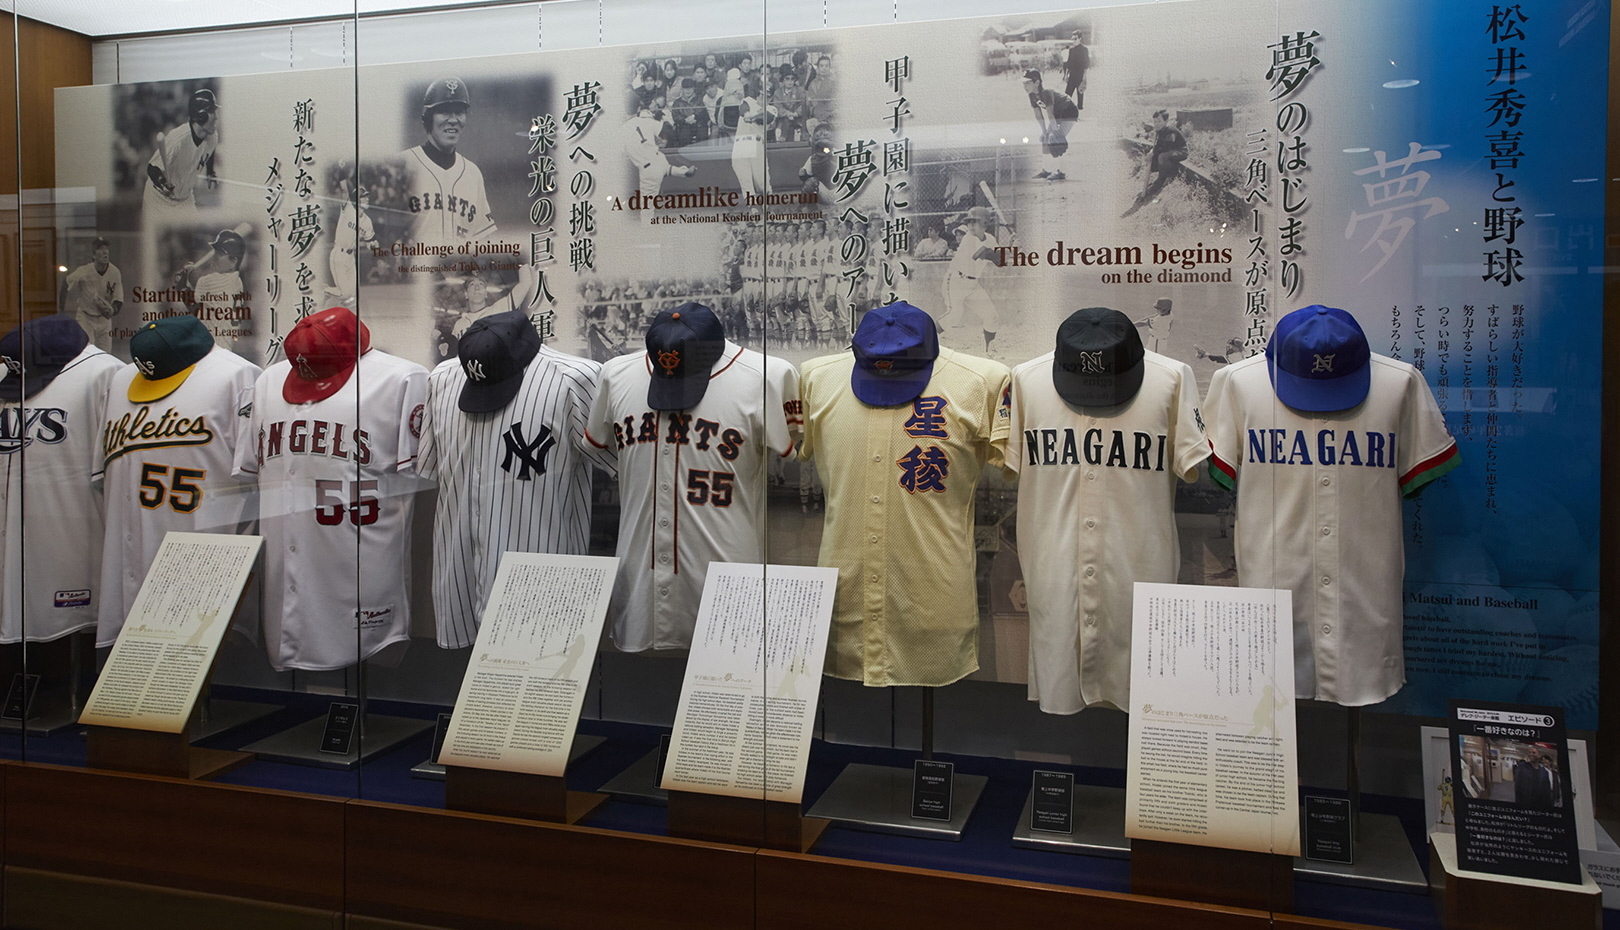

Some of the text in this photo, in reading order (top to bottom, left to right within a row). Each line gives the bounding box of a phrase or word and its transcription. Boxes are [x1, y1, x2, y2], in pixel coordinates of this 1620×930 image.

[1265, 30, 1321, 300] 夢のはじまり
[1482, 4, 1525, 287] 松井秀喜と野球
[562, 81, 602, 272] 夢への挑戦
[409, 193, 477, 223] GIANTS
[611, 186, 819, 211] A dreamlike homerun
[650, 216, 660, 225] at
[662, 214, 677, 224] the
[679, 212, 720, 224] National
[722, 211, 761, 223] Koshien
[1345, 142, 1450, 284] 夢
[527, 114, 556, 340] 栄光の巨人軍
[264, 156, 284, 366] メジャーリーグ
[372, 240, 520, 258] The Challenge of joining
[398, 261, 520, 274] the distinguished Tokyo Giants
[994, 241, 1233, 270] The dream begins
[1102, 268, 1232, 283] on the diamond
[132, 286, 252, 305] Starting afresh with
[195, 302, 252, 321] dream
[109, 328, 118, 337] of
[215, 327, 252, 338] Leagues
[466, 359, 488, 382] NY
[1080, 350, 1106, 375] N
[1311, 353, 1336, 374] N
[1462, 304, 1475, 442] 努力することを惜しまず、
[1512, 304, 1525, 419] 野球が大好きだった。
[1485, 304, 1499, 515] すばらしい指導者と仲間たちに恵まれ、
[257, 420, 373, 467] ANGELS
[500, 421, 556, 482] NY
[613, 411, 744, 462] GIANTS
[895, 394, 951, 496] 星稜
[1023, 427, 1168, 472] NEAGARI
[1247, 428, 1396, 468] NEAGARI
[139, 462, 207, 514] 55
[315, 479, 381, 526] 55
[687, 469, 735, 508] 55
[1410, 592, 1453, 605] Matsui
[1456, 596, 1480, 607] and
[1484, 596, 1538, 610] Baseball
[1453, 628, 1494, 637] outstanding
[1508, 715, 1542, 724] エピソード
